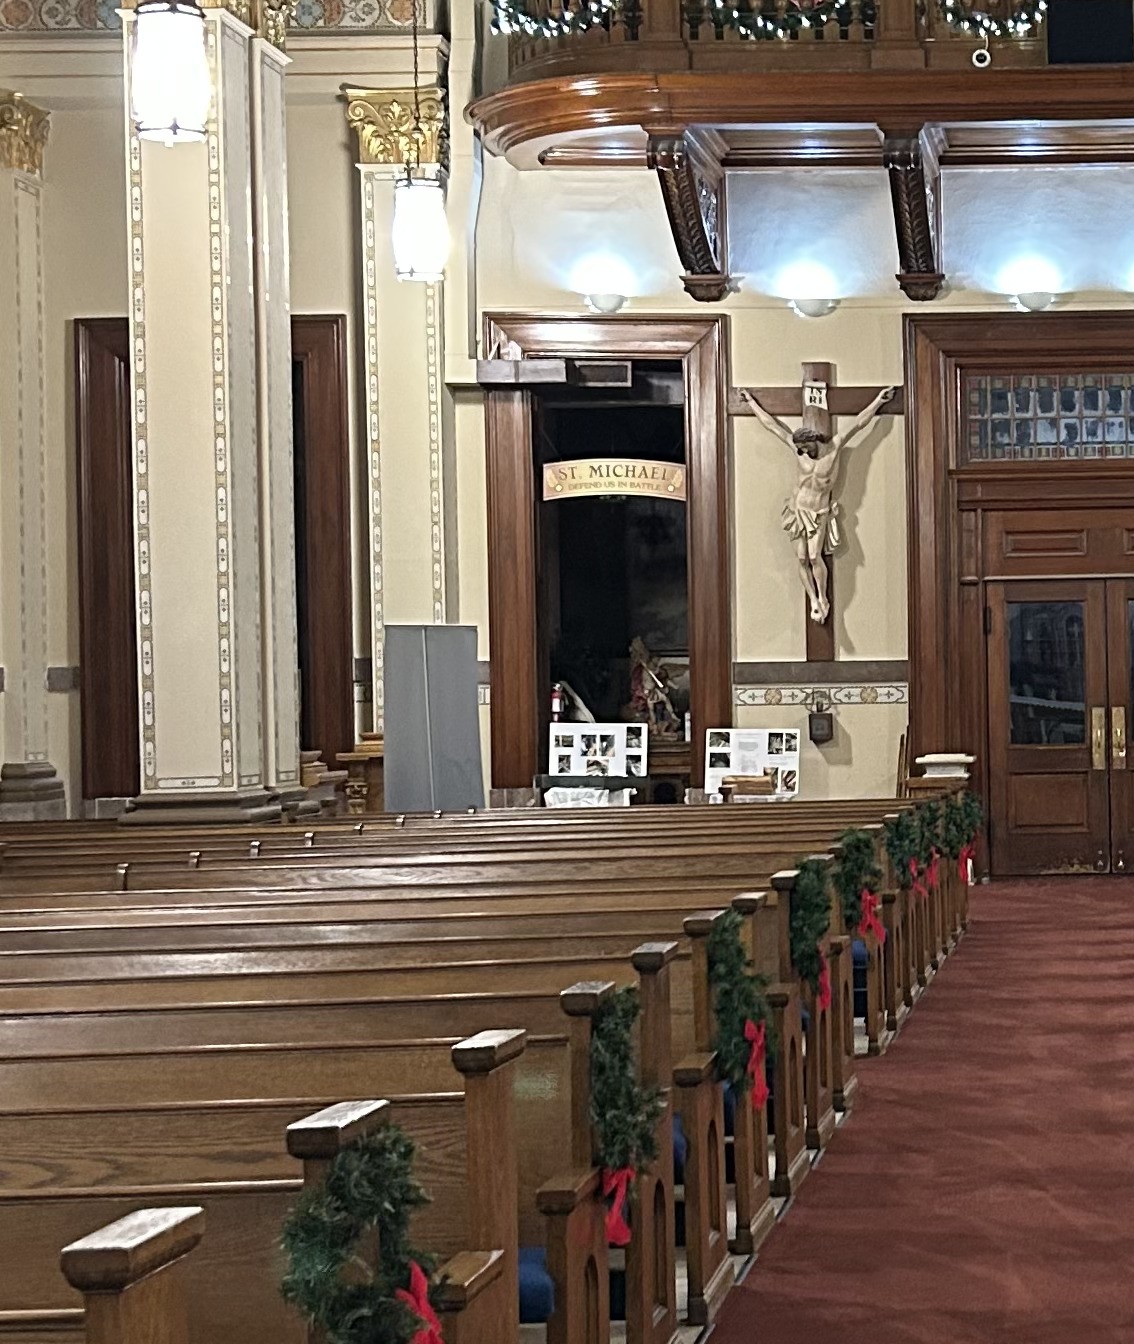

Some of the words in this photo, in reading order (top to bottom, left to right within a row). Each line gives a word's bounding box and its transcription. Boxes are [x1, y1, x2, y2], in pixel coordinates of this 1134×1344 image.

[810, 396, 822, 404] RI
[558, 466, 583, 481] ST.
[589, 464, 671, 481] MICHAEL
[568, 482, 602, 490] DEFEND
[629, 481, 662, 491] BATTLE
